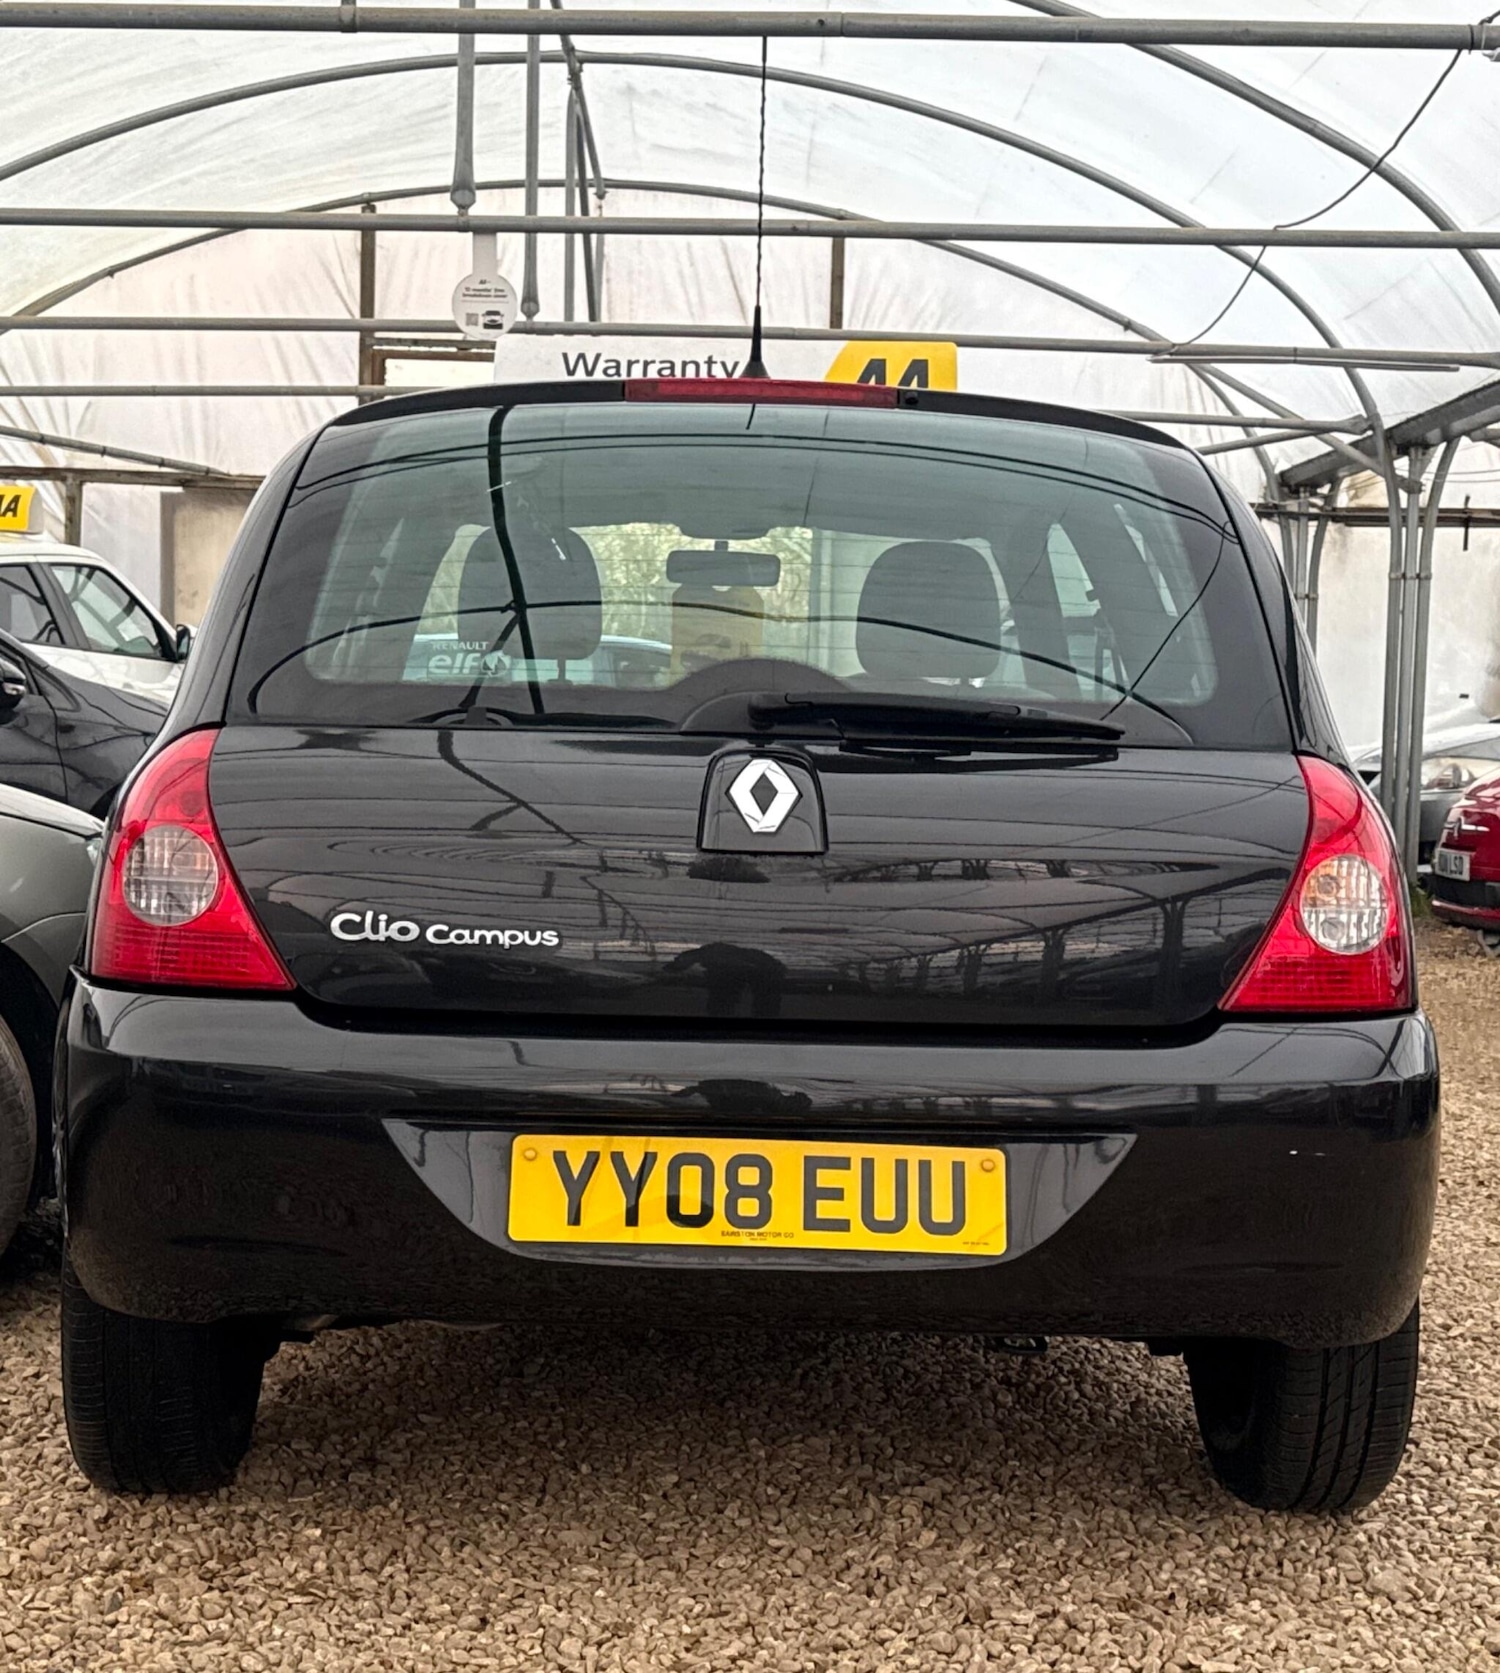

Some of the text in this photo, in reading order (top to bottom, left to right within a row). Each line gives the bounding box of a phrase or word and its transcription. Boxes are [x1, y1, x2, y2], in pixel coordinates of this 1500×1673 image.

[562, 351, 741, 378] Warranty
[0, 494, 21, 517] A
[430, 641, 489, 650] RENAULT
[428, 652, 481, 674] elf
[330, 910, 560, 949] Clio Campus
[552, 1150, 966, 1236] YY08 EUU
